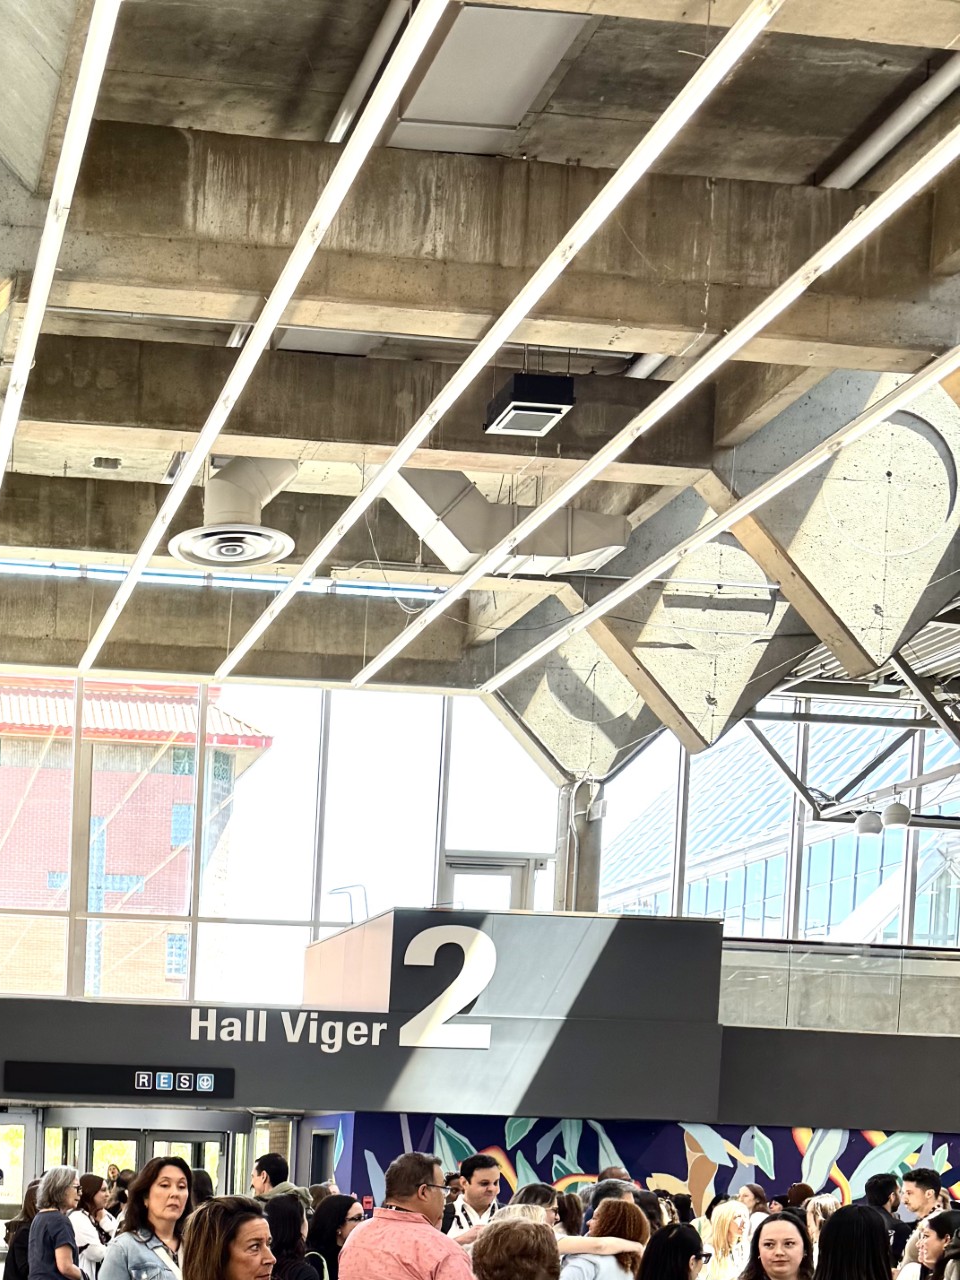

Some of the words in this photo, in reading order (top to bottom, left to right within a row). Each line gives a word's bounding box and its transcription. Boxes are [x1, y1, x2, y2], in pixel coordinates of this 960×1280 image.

[190, 1008, 267, 1043] Hall
[280, 1010, 388, 1054] Viger
[398, 924, 497, 1050] 2
